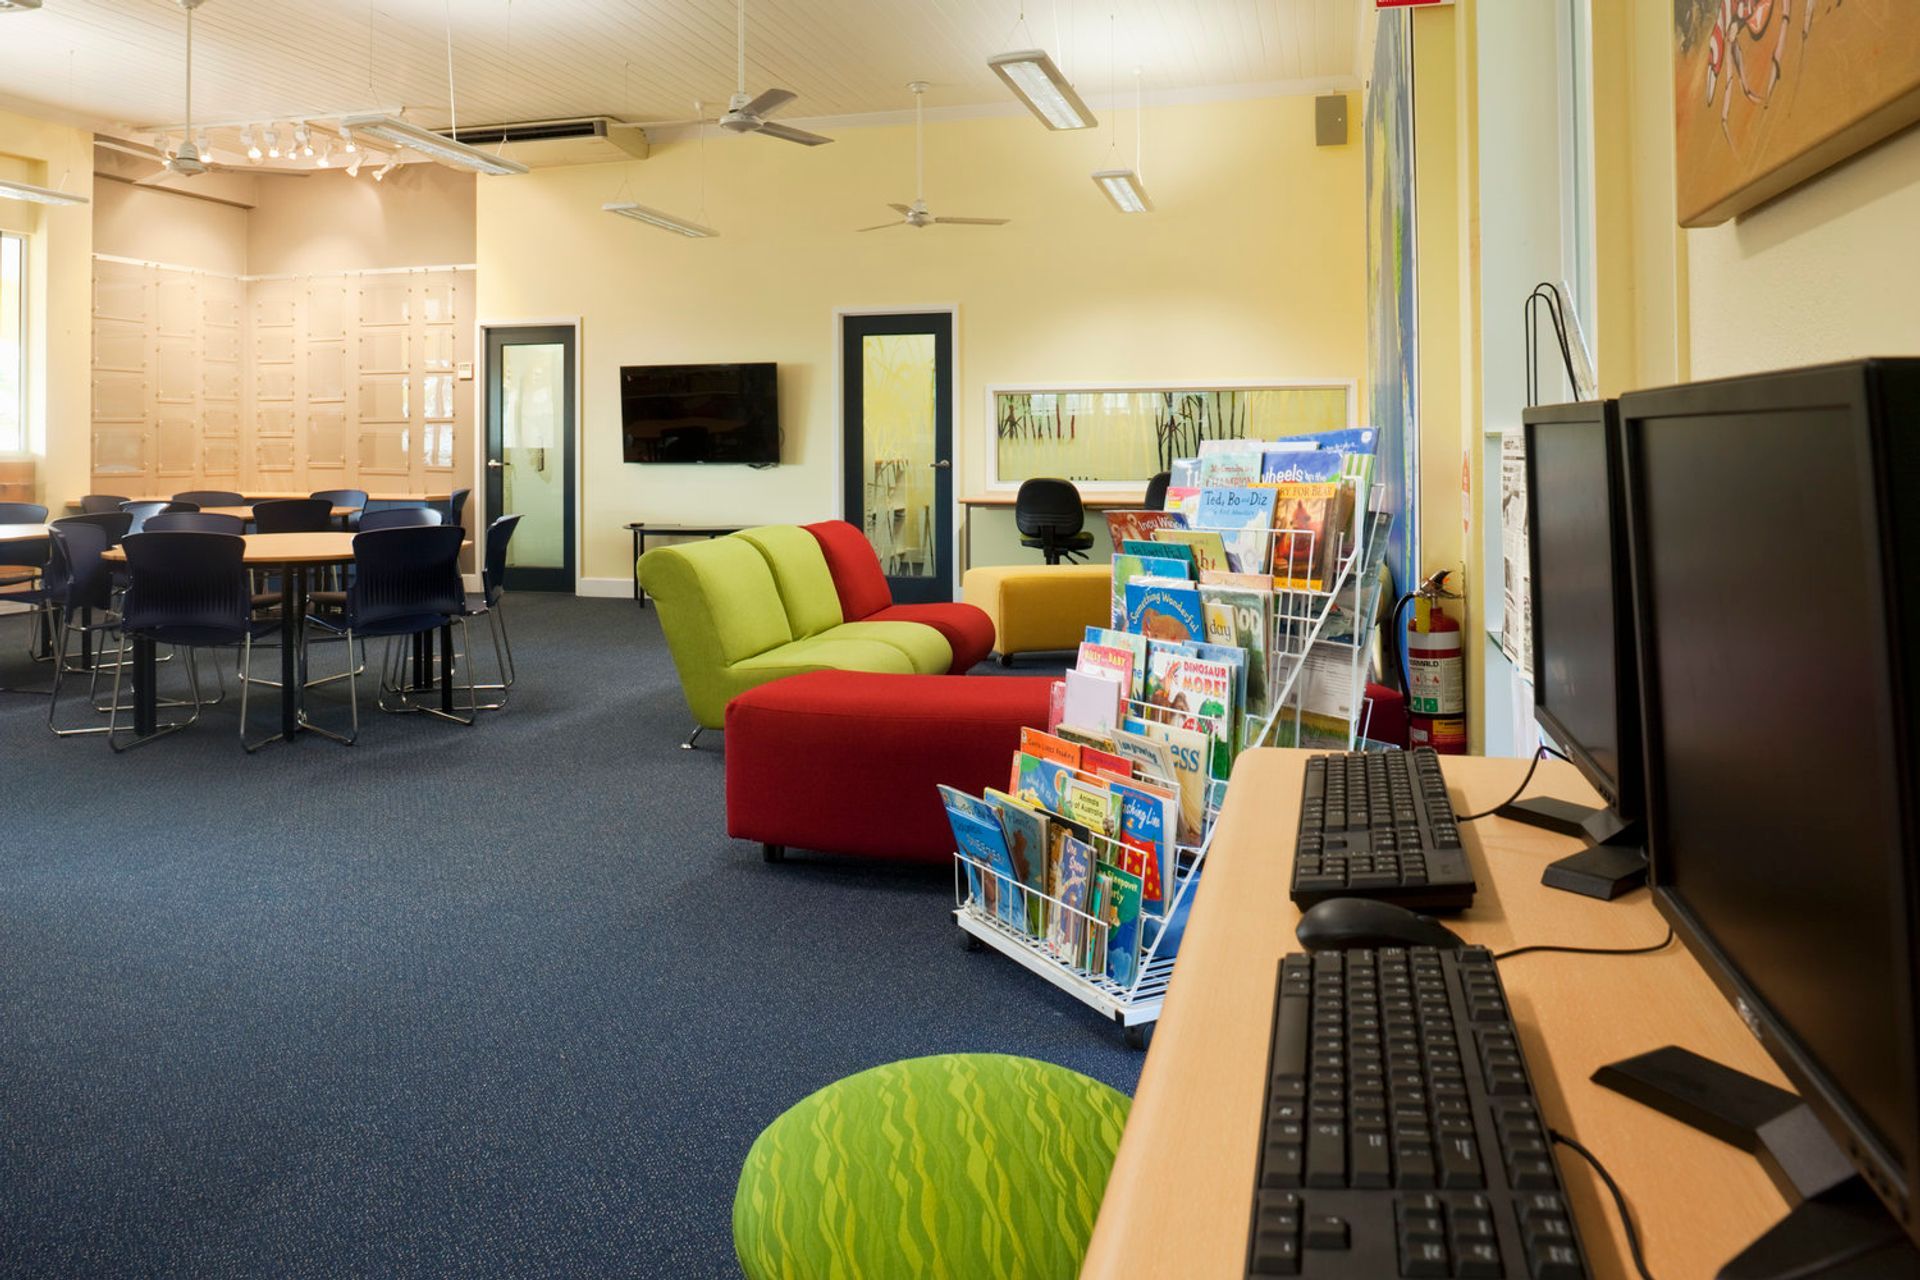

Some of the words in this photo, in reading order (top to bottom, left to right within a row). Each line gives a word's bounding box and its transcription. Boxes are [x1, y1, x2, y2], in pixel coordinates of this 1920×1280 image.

[1204, 490, 1224, 506] Ted,
[1227, 491, 1240, 506] Bo
[1249, 491, 1268, 506] Diz
[1130, 591, 1161, 625] Something
[1161, 591, 1201, 633] Wonderful
[1209, 619, 1231, 641] day
[1184, 661, 1227, 679] DINOSAUR
[1182, 675, 1227, 699] MORE!
[1079, 793, 1100, 808] Animals
[1107, 870, 1138, 893] Sleepover
